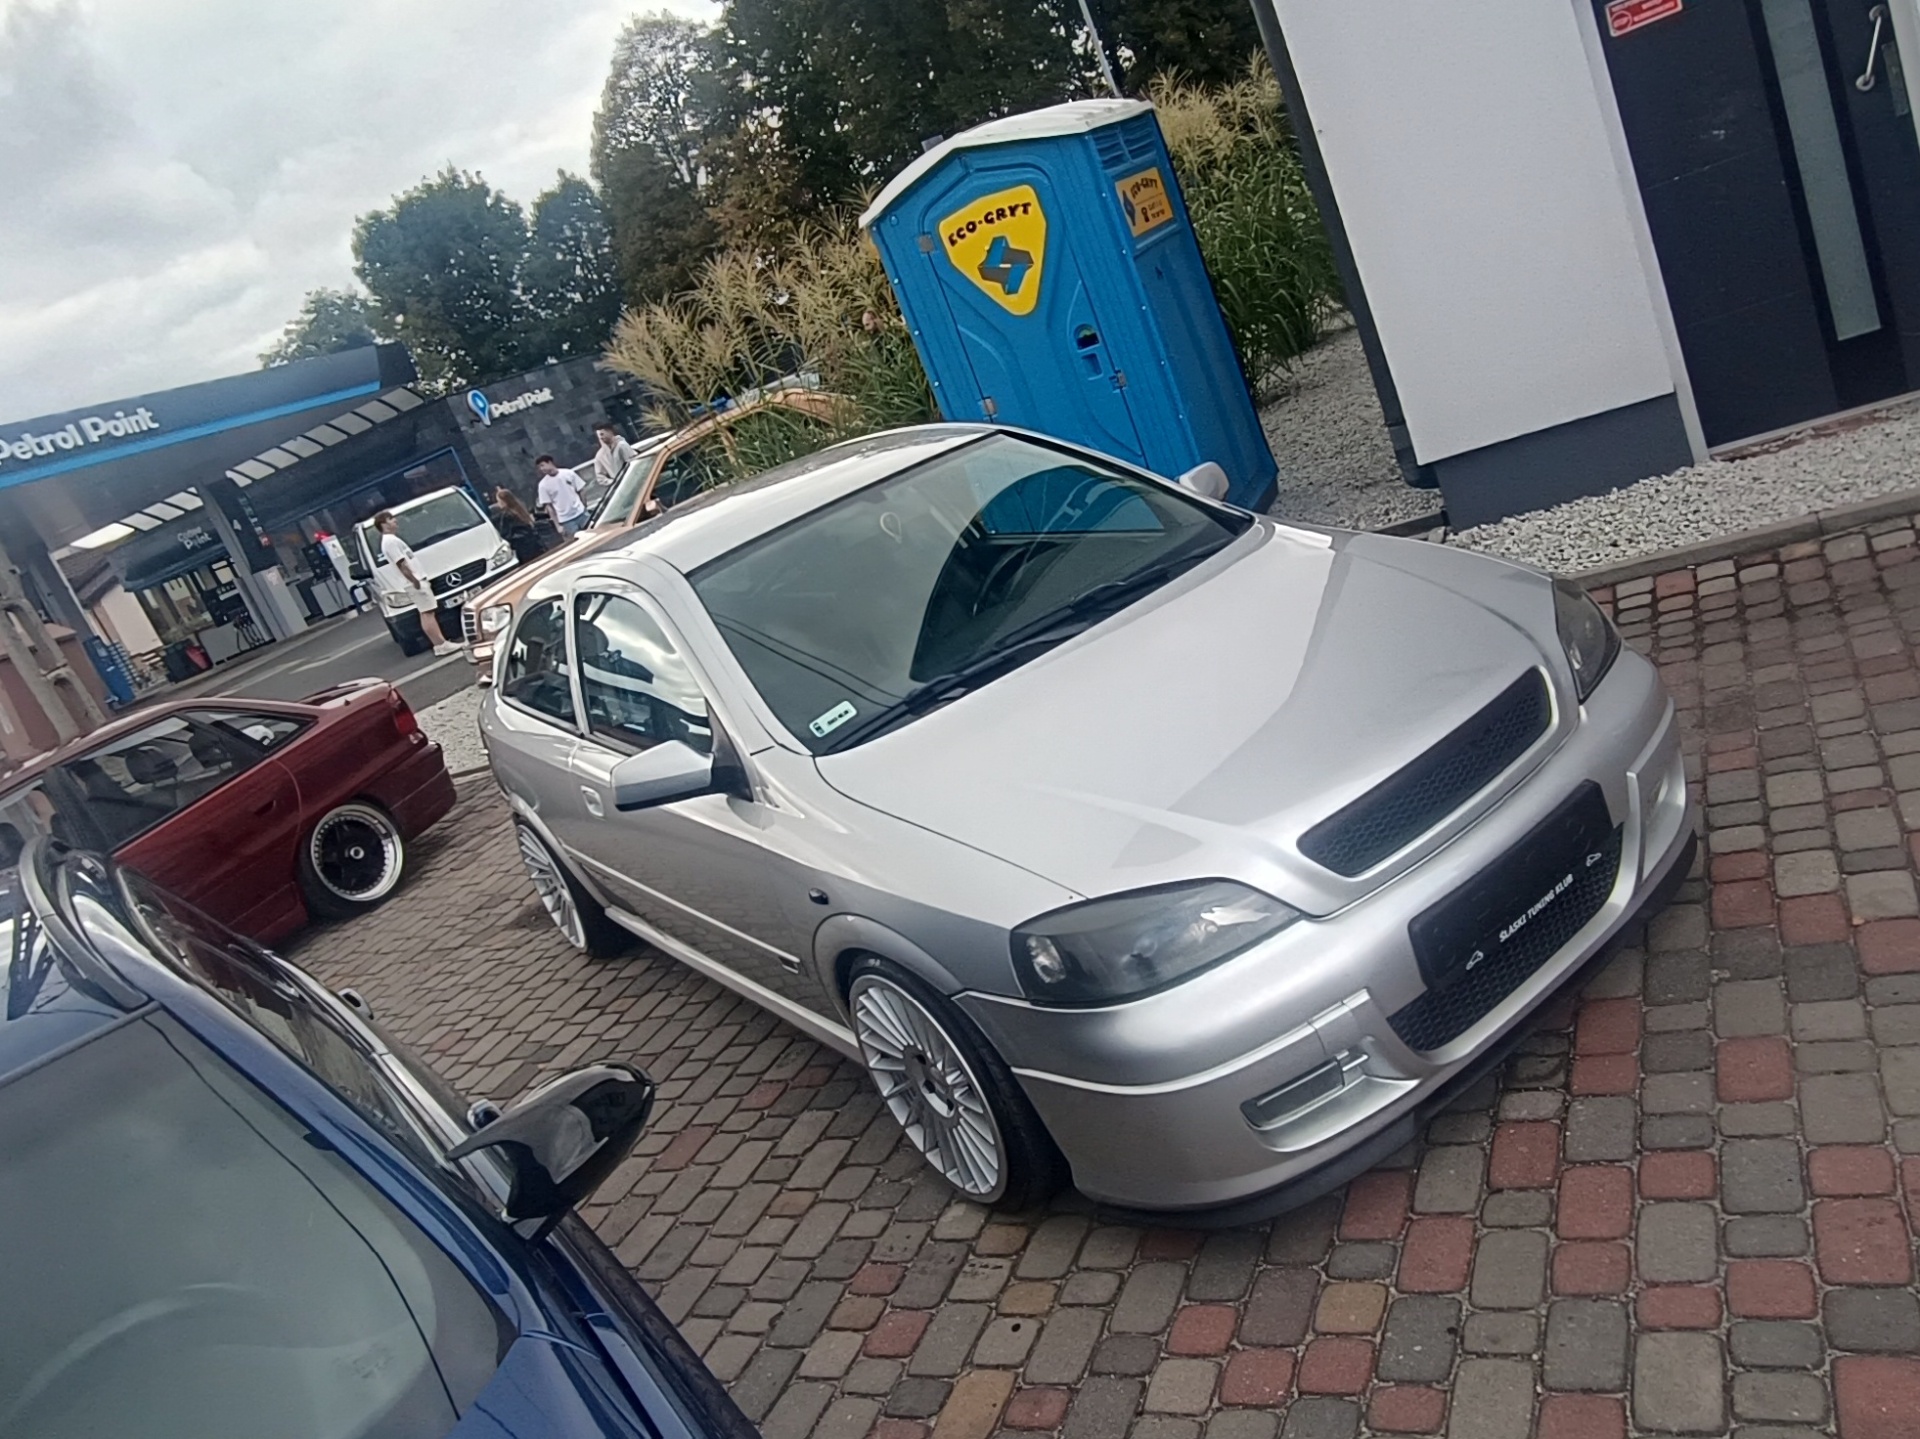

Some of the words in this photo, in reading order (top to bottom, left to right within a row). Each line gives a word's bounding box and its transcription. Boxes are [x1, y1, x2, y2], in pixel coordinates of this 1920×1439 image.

[79, 407, 160, 443] Point
[1527, 889, 1556, 919] TUNING
[1555, 873, 1574, 896] KLUB
